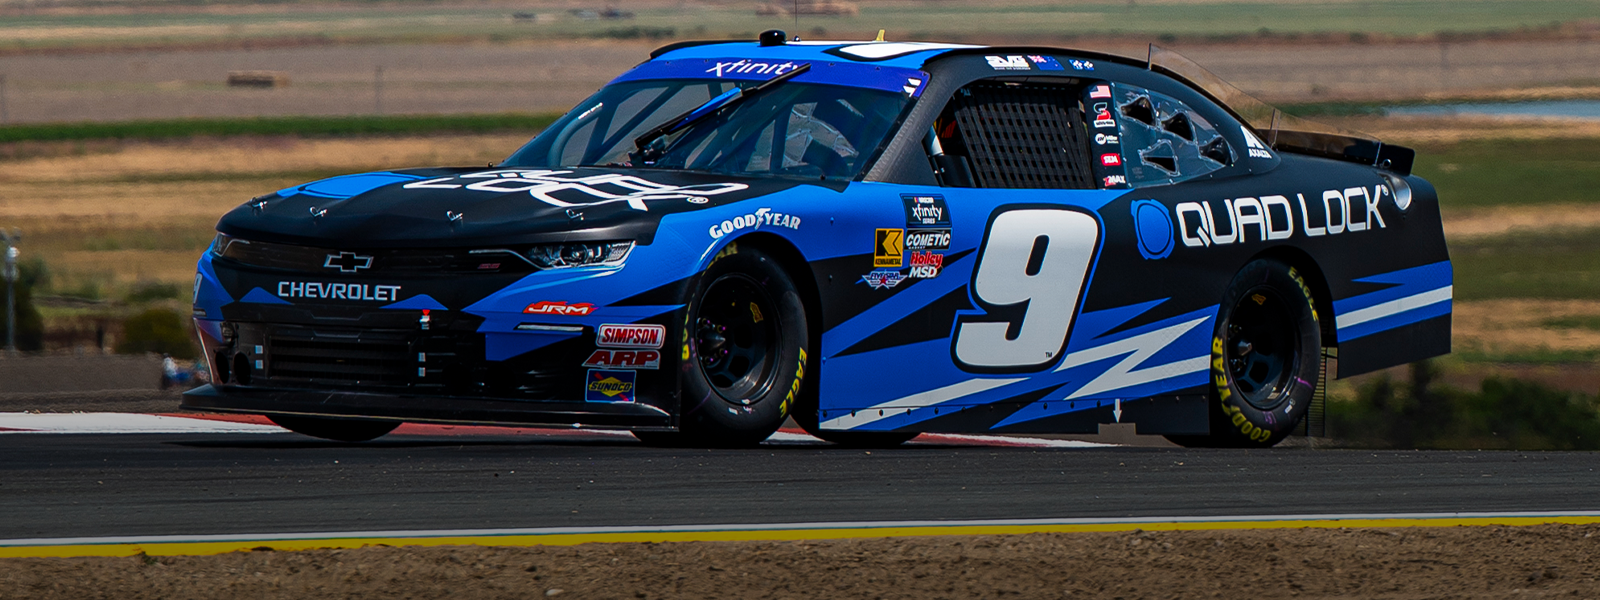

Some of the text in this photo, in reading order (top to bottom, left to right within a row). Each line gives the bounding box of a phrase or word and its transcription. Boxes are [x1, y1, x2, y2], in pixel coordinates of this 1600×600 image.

[705, 59, 798, 77] xfinit
[911, 203, 943, 221] xfinity
[709, 208, 801, 239] GOODYEAR
[1175, 195, 1294, 248] QUAD
[905, 232, 951, 247] COMETIC
[909, 250, 943, 269] Holley
[908, 266, 937, 278] MSD
[277, 281, 402, 302] CHEVROLET
[955, 208, 1099, 367] 9
[1288, 266, 1319, 322] EAGLE
[528, 304, 589, 316] JRM
[601, 327, 659, 345] SIMPSON
[586, 351, 659, 366] ARP
[591, 382, 632, 393] SUNOCO
[779, 347, 808, 419] EAGLE
[1212, 336, 1272, 443] GOODYEAR
